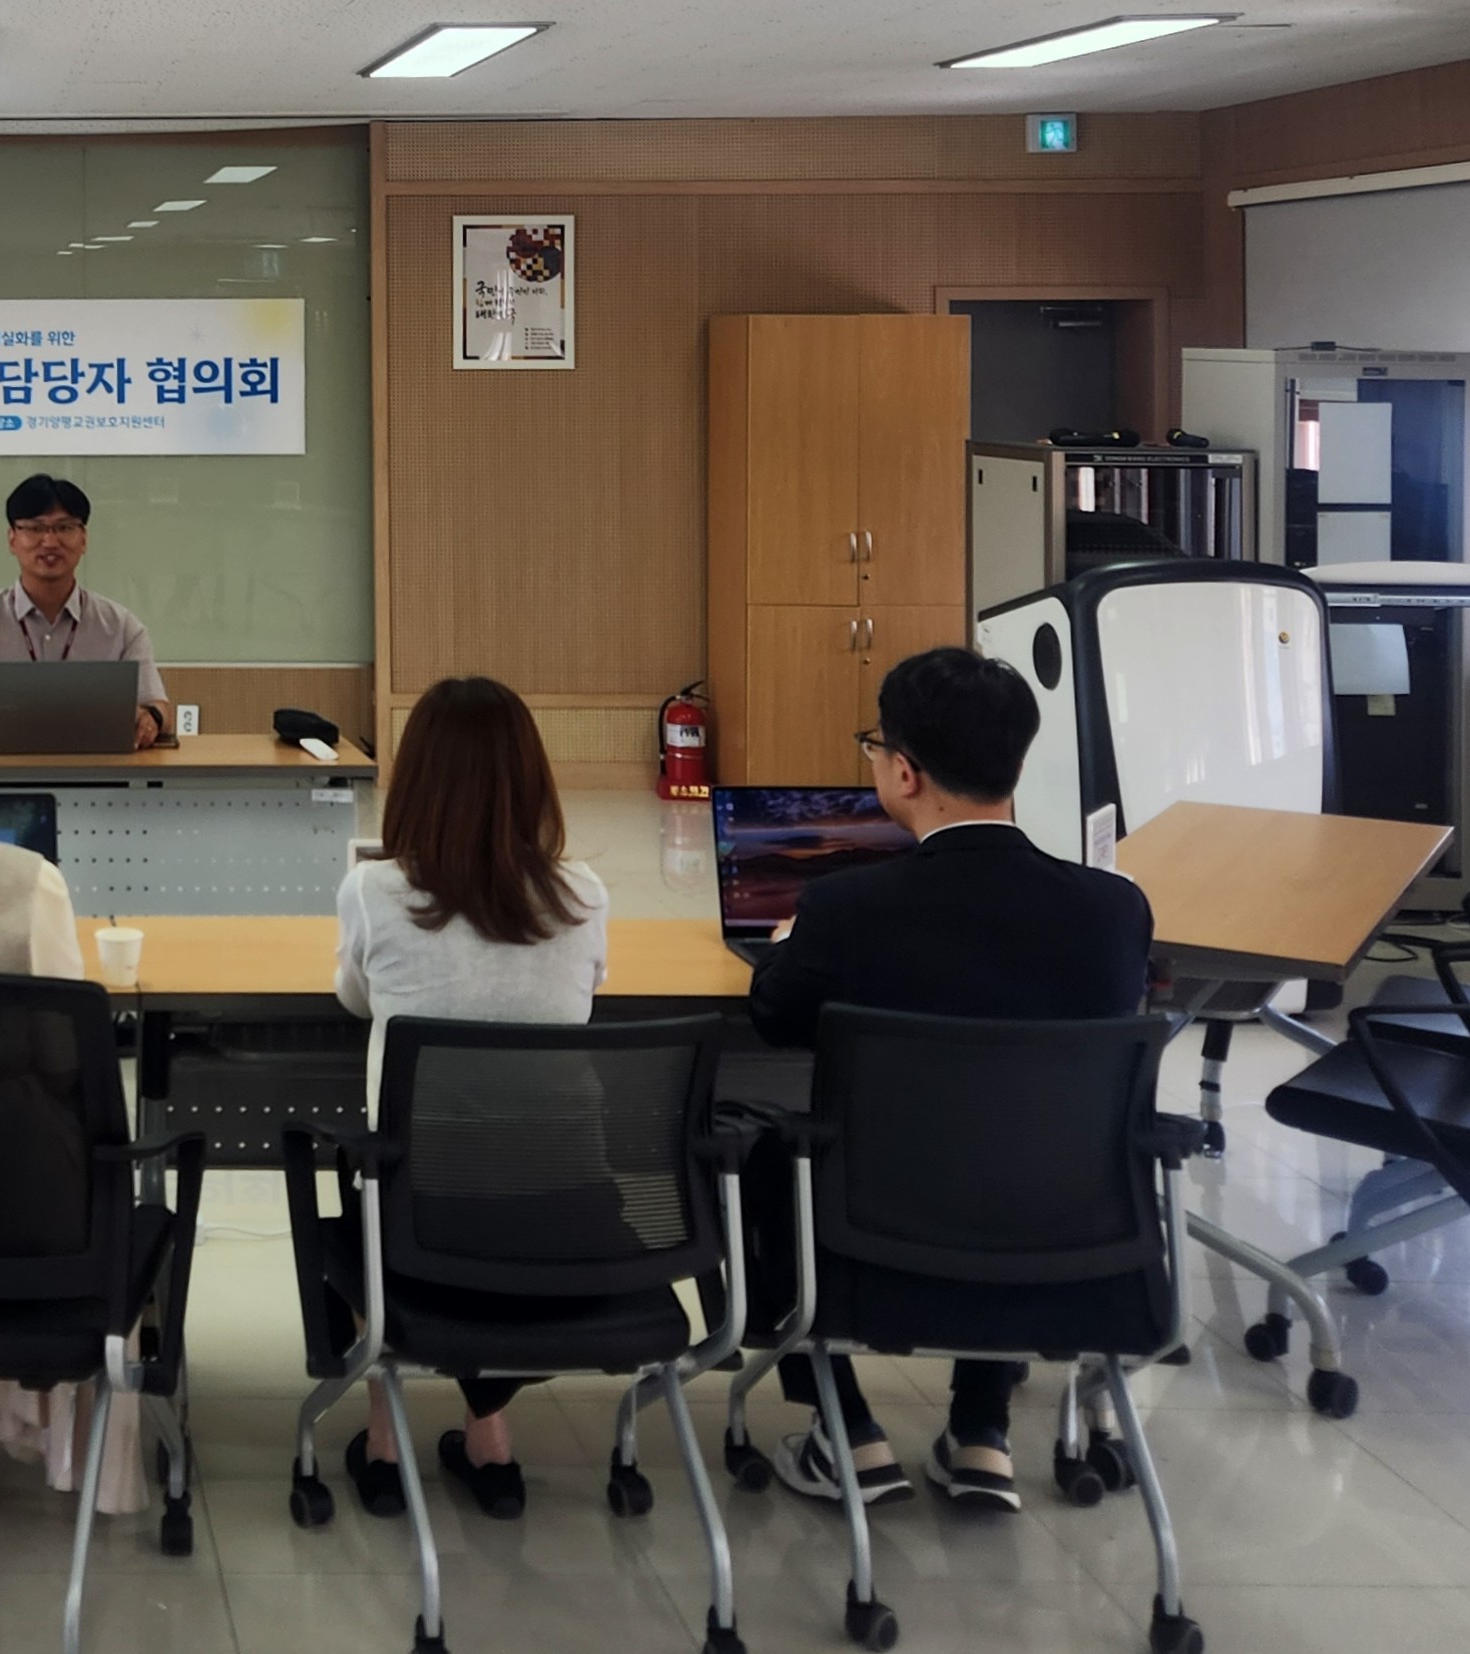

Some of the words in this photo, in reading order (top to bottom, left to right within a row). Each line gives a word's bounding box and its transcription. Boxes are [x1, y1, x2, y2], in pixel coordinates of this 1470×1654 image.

[47, 330, 76, 346] 위한
[146, 357, 279, 404] 협의회
[26, 416, 166, 430] 경기양평교권보호지원센터
